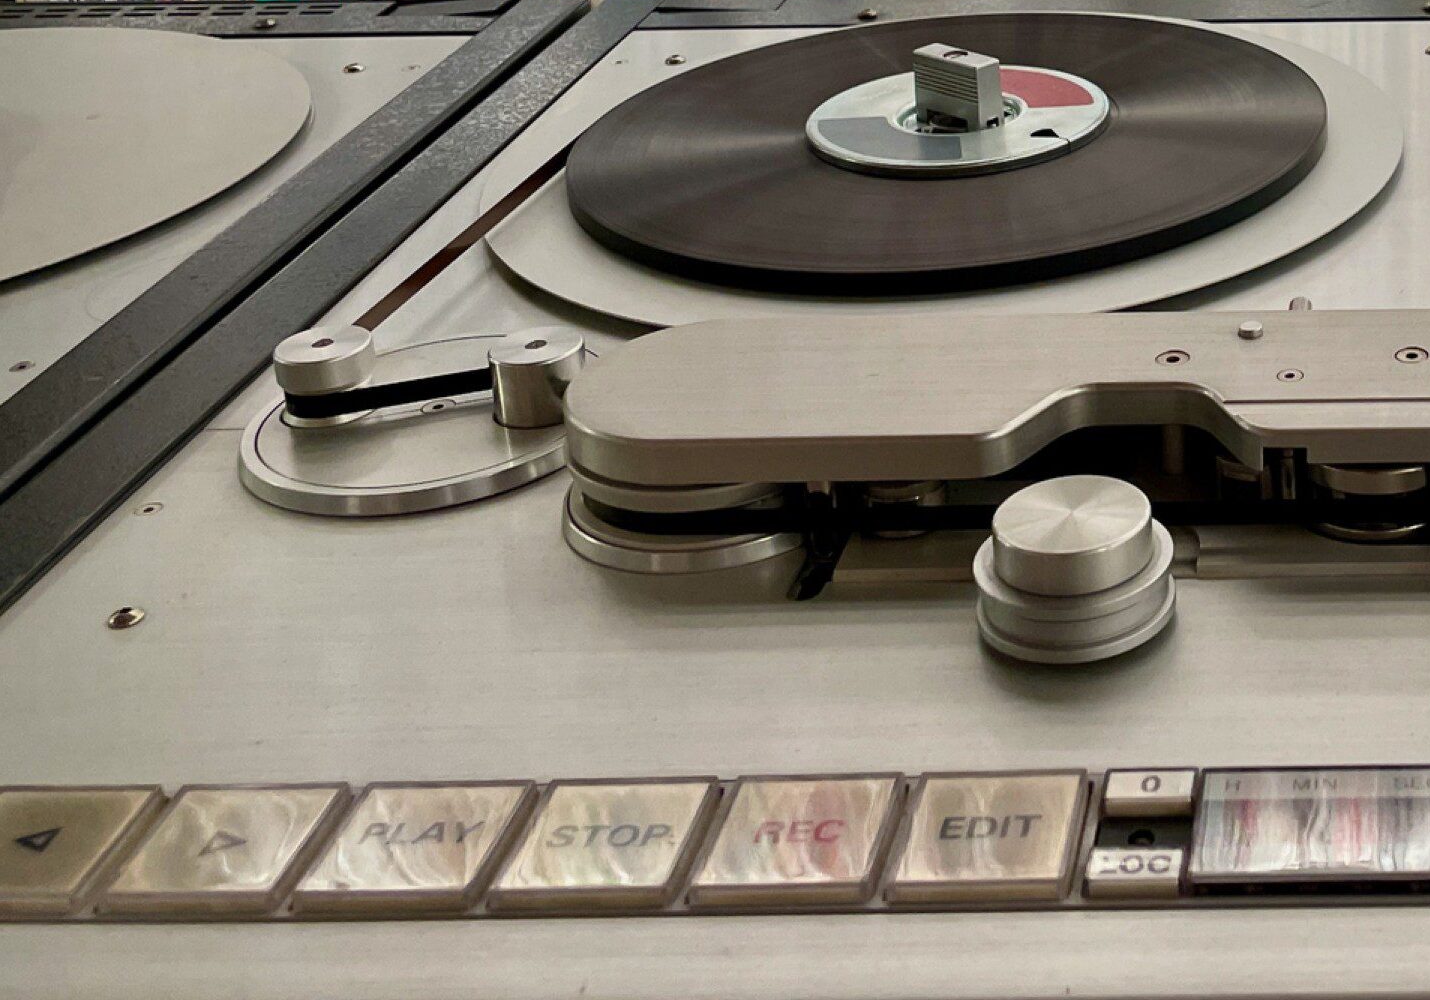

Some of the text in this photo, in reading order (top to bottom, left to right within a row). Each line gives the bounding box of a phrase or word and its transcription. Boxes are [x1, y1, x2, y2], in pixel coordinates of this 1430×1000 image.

[1292, 777, 1338, 791] MIN
[358, 820, 486, 845] PLAY
[546, 823, 673, 849] STOP
[753, 818, 845, 844] REC
[938, 814, 1043, 841] EDIT
